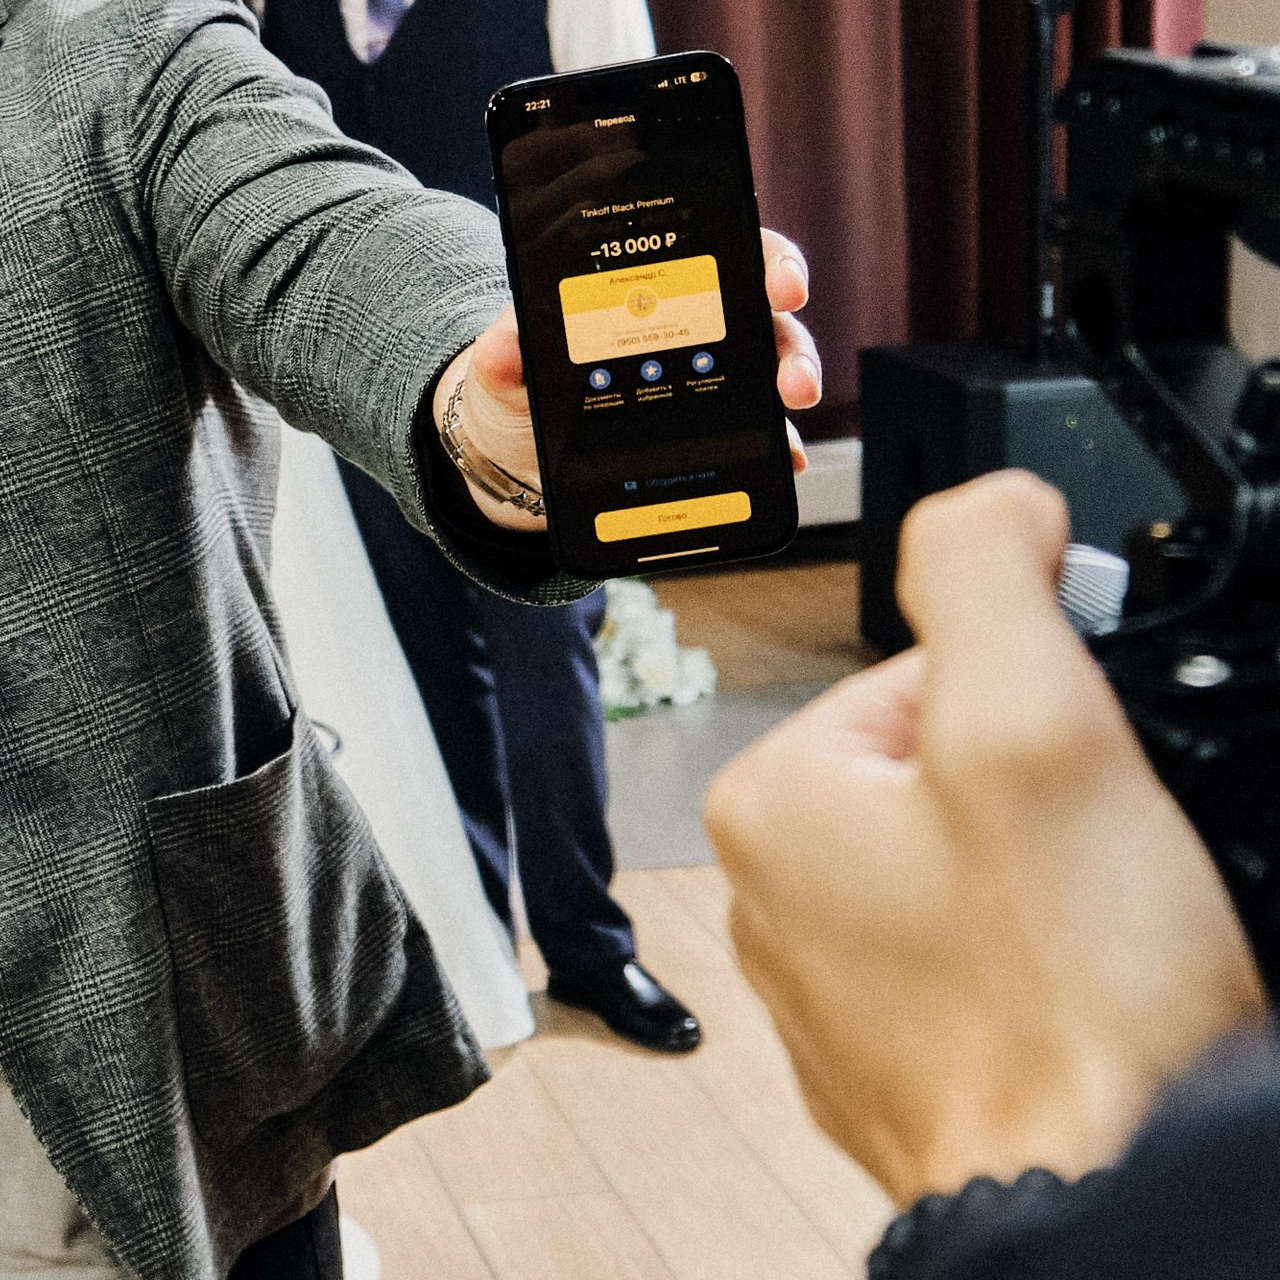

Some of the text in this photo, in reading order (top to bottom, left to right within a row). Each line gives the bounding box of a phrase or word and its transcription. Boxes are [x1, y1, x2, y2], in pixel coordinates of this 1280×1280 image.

[674, 75, 687, 86] LTE
[525, 99, 551, 112] 22:21
[594, 114, 636, 128] Перевод
[581, 196, 674, 218] Tinkoff Black Premium
[624, 234, 662, 254] 000
[658, 512, 687, 523] Готово
